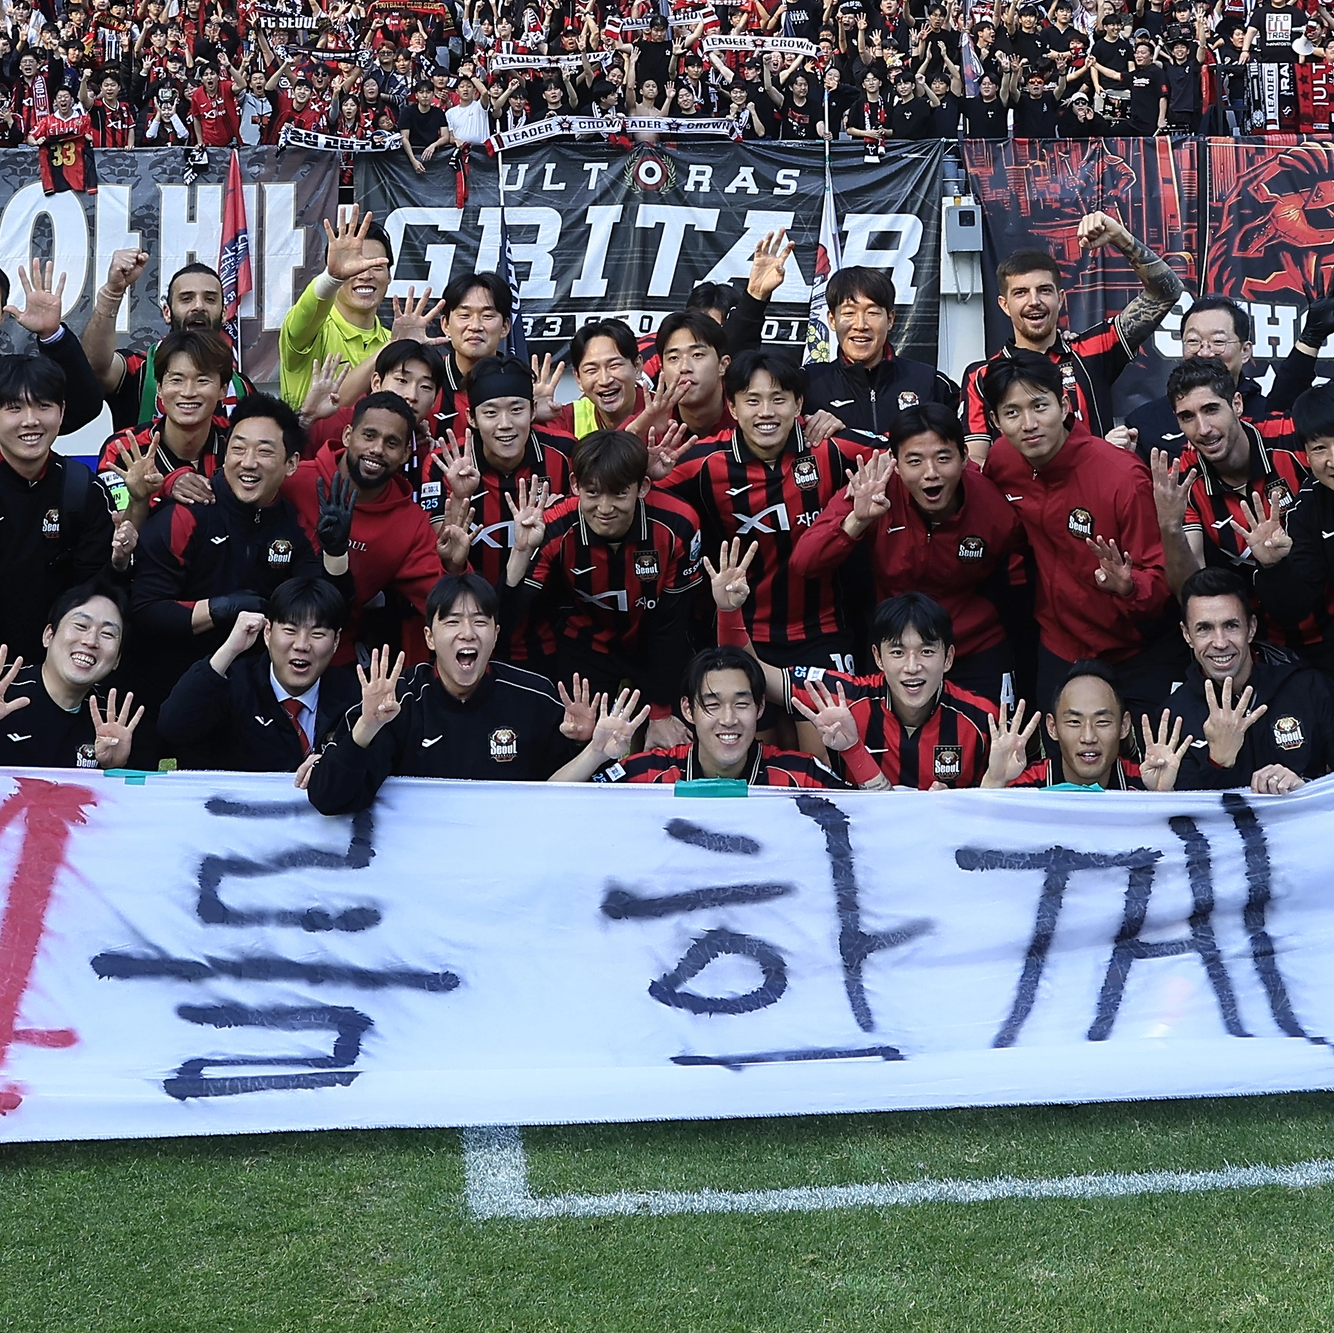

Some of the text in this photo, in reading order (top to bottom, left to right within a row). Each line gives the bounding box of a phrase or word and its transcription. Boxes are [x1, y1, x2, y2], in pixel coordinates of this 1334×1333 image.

[706, 37, 815, 53] LEADER CROWN
[506, 122, 554, 143] LEADER
[51, 143, 75, 166] 33
[794, 471, 819, 486] Seoul
[268, 549, 292, 565] Seoul
[635, 561, 660, 576] Seoul
[1273, 729, 1305, 746] Seoul
[489, 742, 518, 756] Seoul
